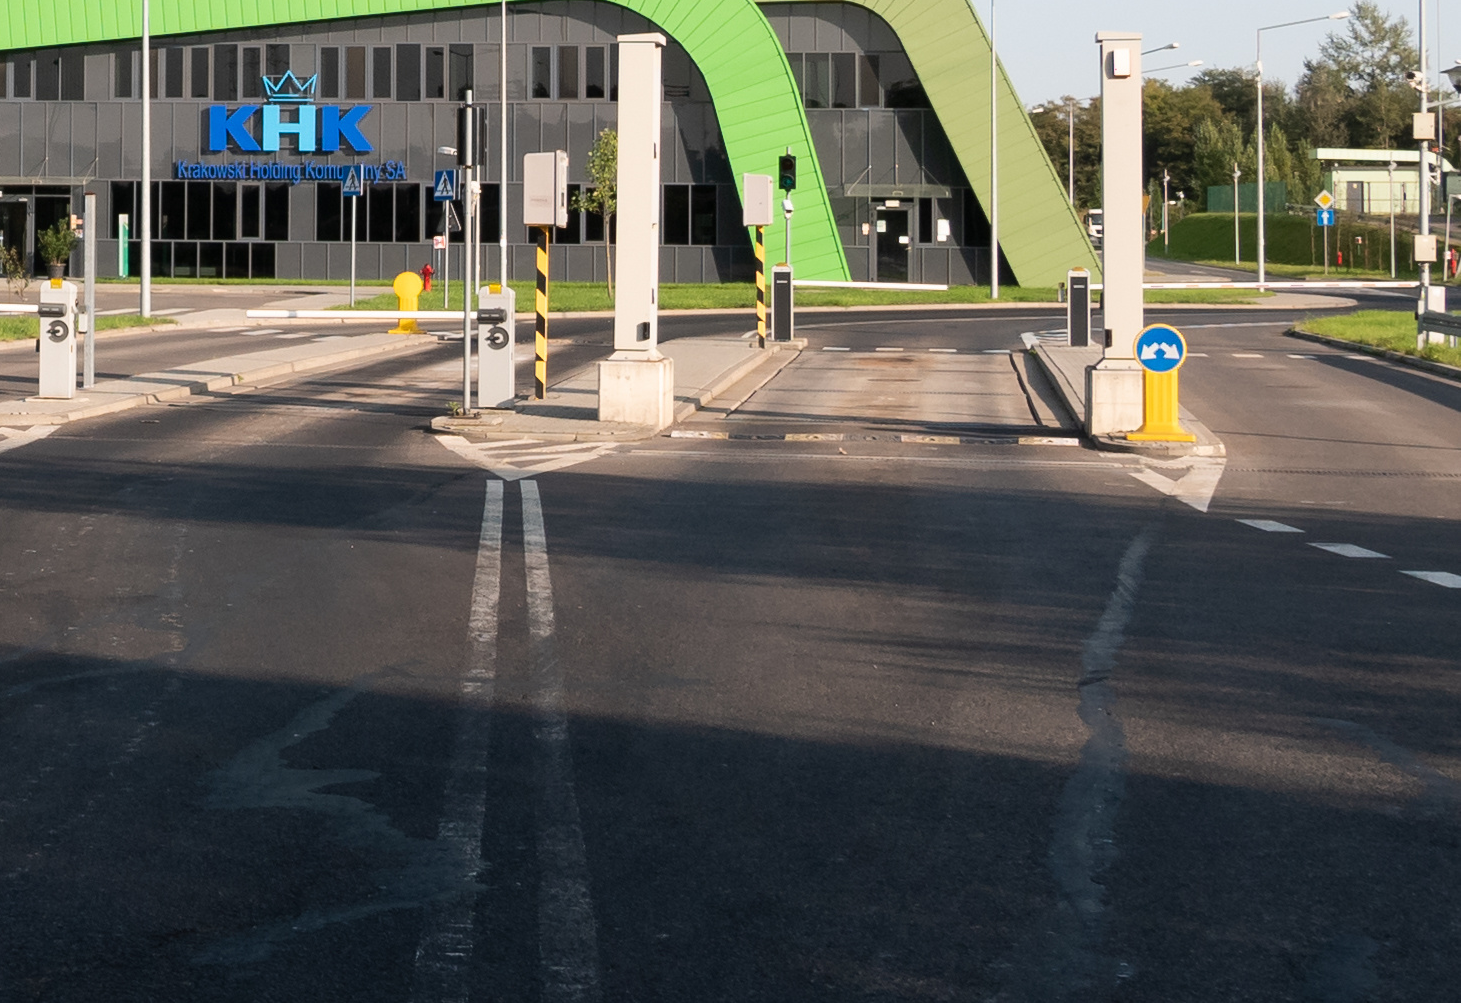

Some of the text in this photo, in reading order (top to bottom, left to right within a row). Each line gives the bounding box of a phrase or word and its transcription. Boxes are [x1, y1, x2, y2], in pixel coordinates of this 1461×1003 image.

[209, 104, 374, 151] KHK
[178, 159, 407, 184] Krakowski Holding Komuny SA
